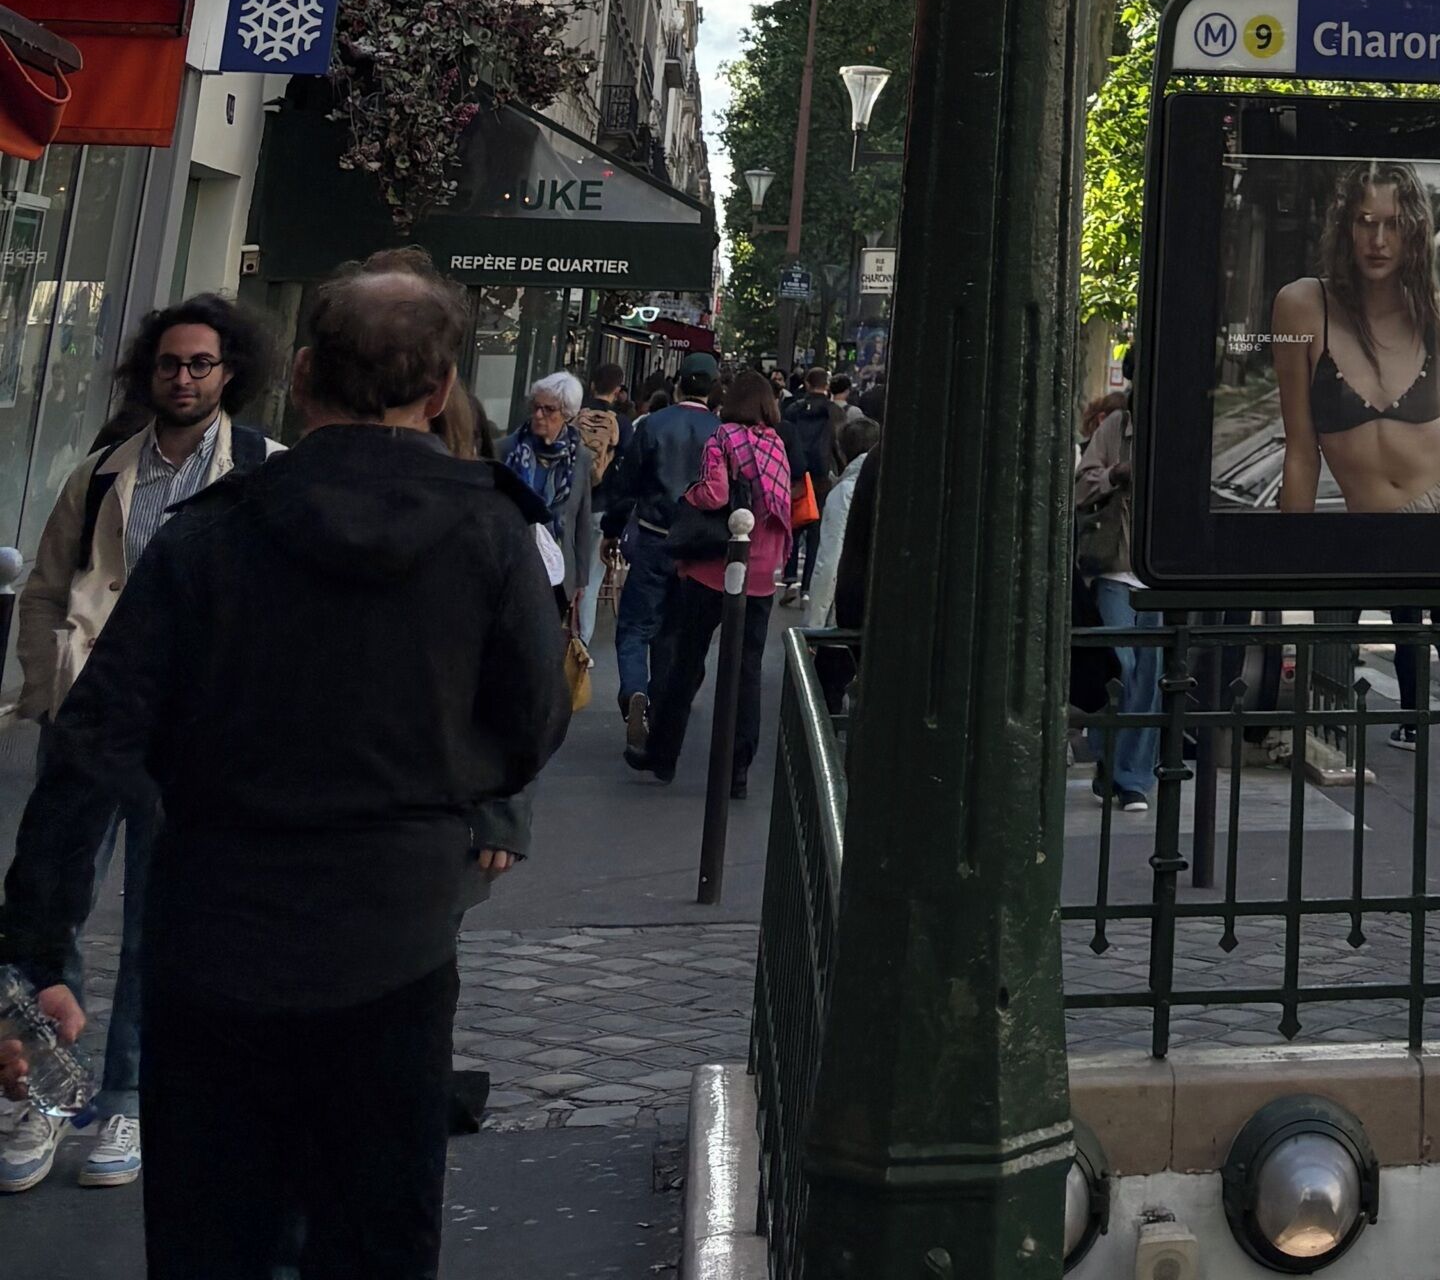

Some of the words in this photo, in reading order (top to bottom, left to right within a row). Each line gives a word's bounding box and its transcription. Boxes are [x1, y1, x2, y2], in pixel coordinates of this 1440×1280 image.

[1255, 24, 1273, 50] 9
[451, 253, 517, 271] REPÈRE
[520, 257, 543, 271] DE
[547, 258, 629, 274] QUARTIER
[1228, 333, 1256, 342] HAUT
[1257, 334, 1271, 343] DE
[1272, 334, 1314, 343] MAILLOT
[1254, 343, 1262, 352] €
